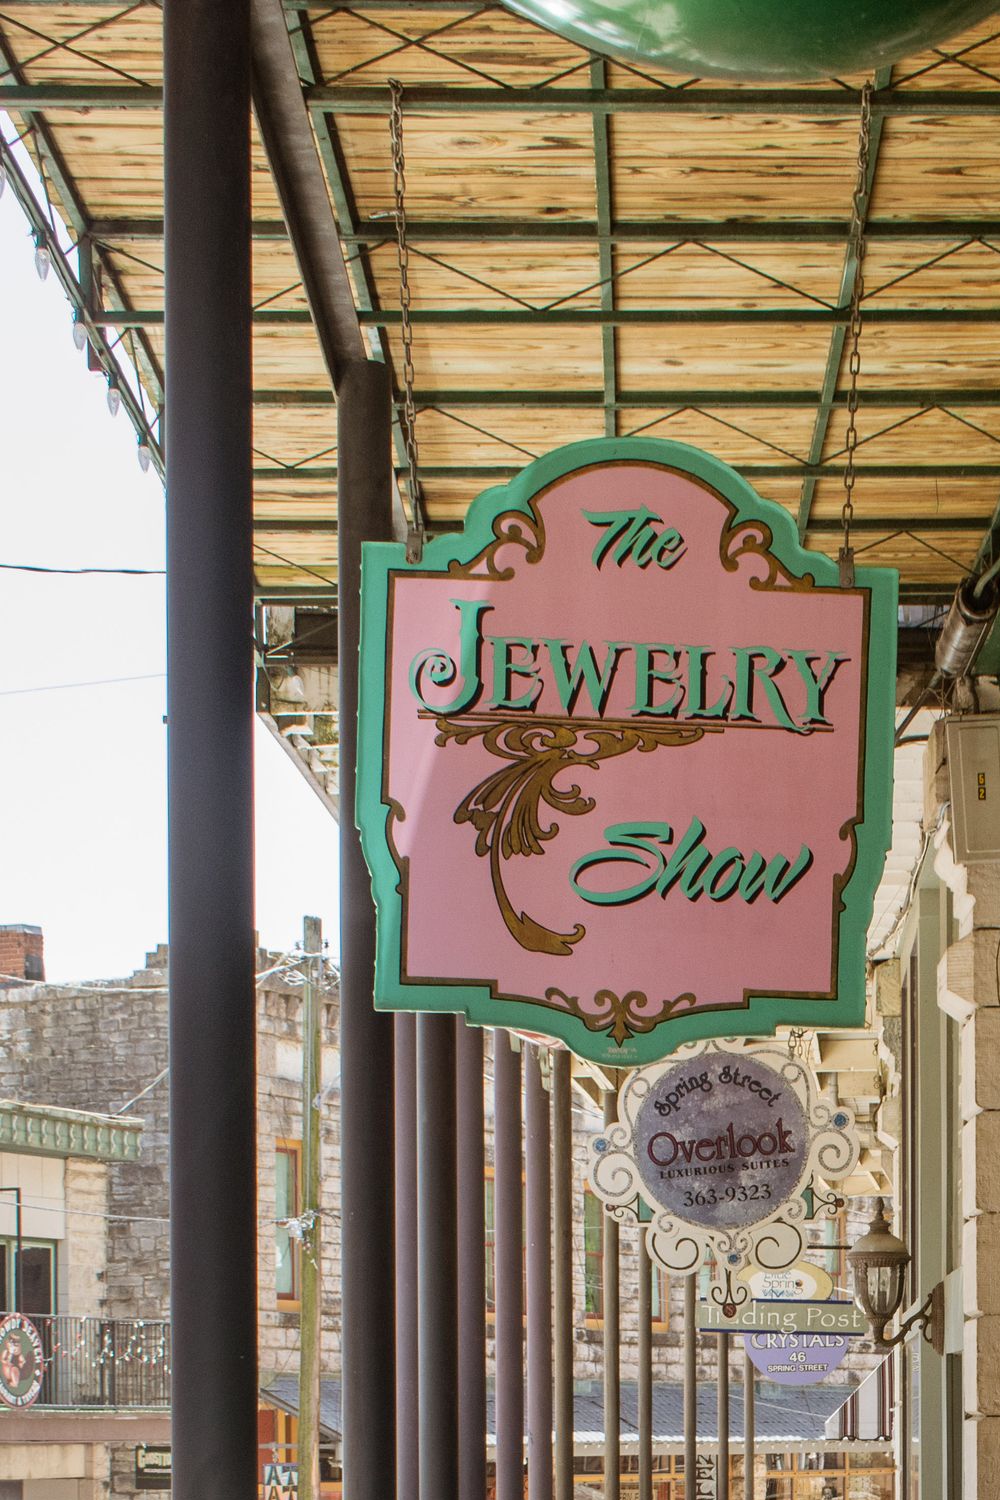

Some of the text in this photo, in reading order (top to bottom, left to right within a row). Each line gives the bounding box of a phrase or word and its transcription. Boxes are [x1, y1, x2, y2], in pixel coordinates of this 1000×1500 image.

[581, 503, 688, 569] The
[569, 816, 815, 905] Show
[654, 1065, 782, 1116] Spring Street
[647, 1117, 796, 1167] Overlook
[660, 1158, 790, 1179] LUXURIOUS SUITES
[683, 1183, 772, 1207] 363-9323
[761, 1278, 804, 1296] Spring
[701, 1300, 862, 1334] Trding Post
[751, 1333, 845, 1349] CRYSTALS
[767, 1363, 828, 1373] SPRING STREET
[789, 1352, 806, 1363] 46
